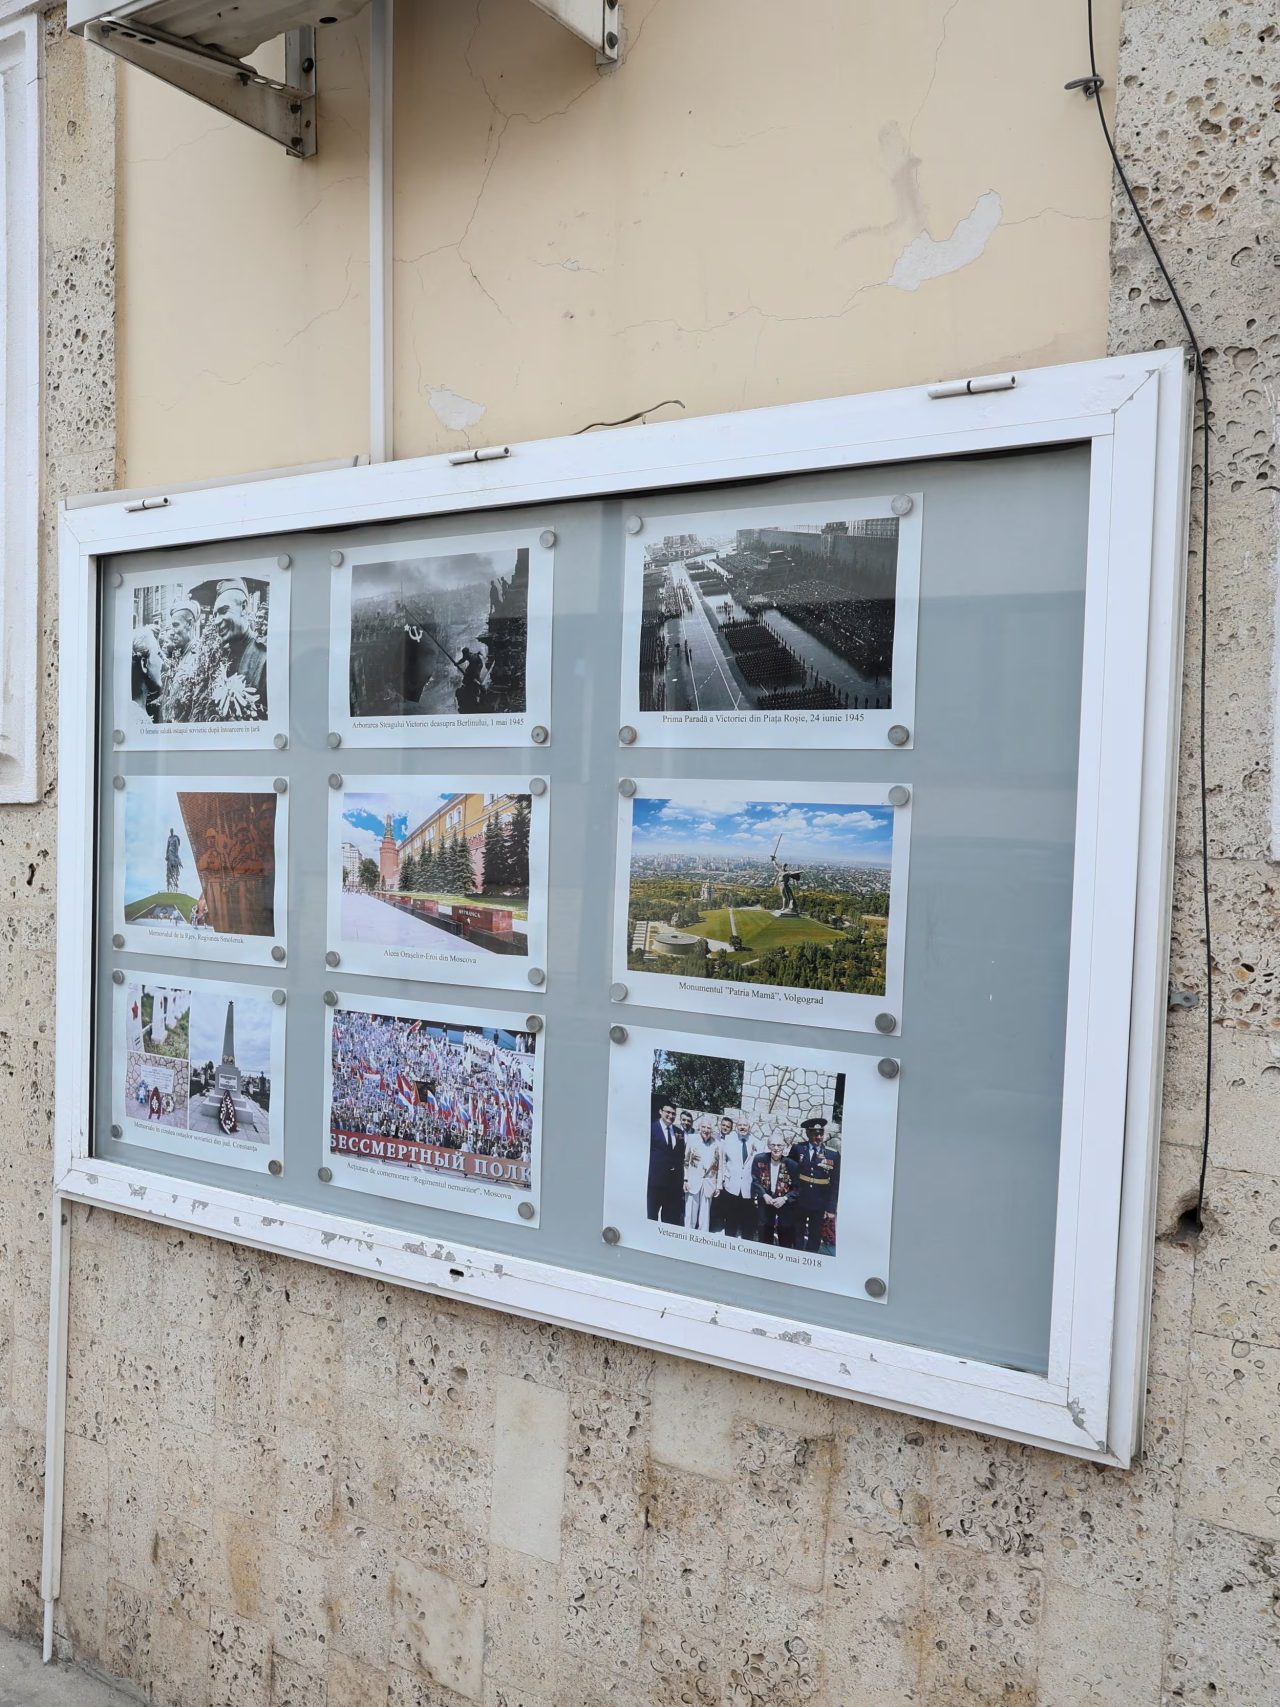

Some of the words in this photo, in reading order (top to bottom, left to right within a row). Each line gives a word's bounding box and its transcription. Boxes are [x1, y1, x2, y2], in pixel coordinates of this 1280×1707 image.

[429, 720, 456, 729] deasupra
[509, 718, 525, 726] 1945
[662, 715, 683, 723] Prima
[684, 715, 708, 723] Paradă
[716, 714, 747, 723] Victoriei
[749, 714, 761, 723] din
[810, 713, 820, 722] 24
[822, 713, 842, 722] iunie
[845, 713, 865, 722] 1945
[383, 949, 399, 957] Aleea
[438, 953, 449, 962] din
[449, 955, 477, 964] Moscova
[678, 981, 724, 994] Monumentul
[783, 992, 824, 1005] Volgograd
[330, 1133, 465, 1171] БЕССМЕРТНЫЙ
[474, 1158, 531, 1182] ПОЛК
[376, 1170, 410, 1181] comemorare
[483, 1189, 512, 1200] Moscova
[658, 1227, 688, 1241] Veteranii
[689, 1234, 727, 1249] Războiului
[729, 1242, 736, 1251] la
[778, 1253, 784, 1261] 9
[785, 1256, 800, 1264] mai
[802, 1257, 822, 1268] 2018
